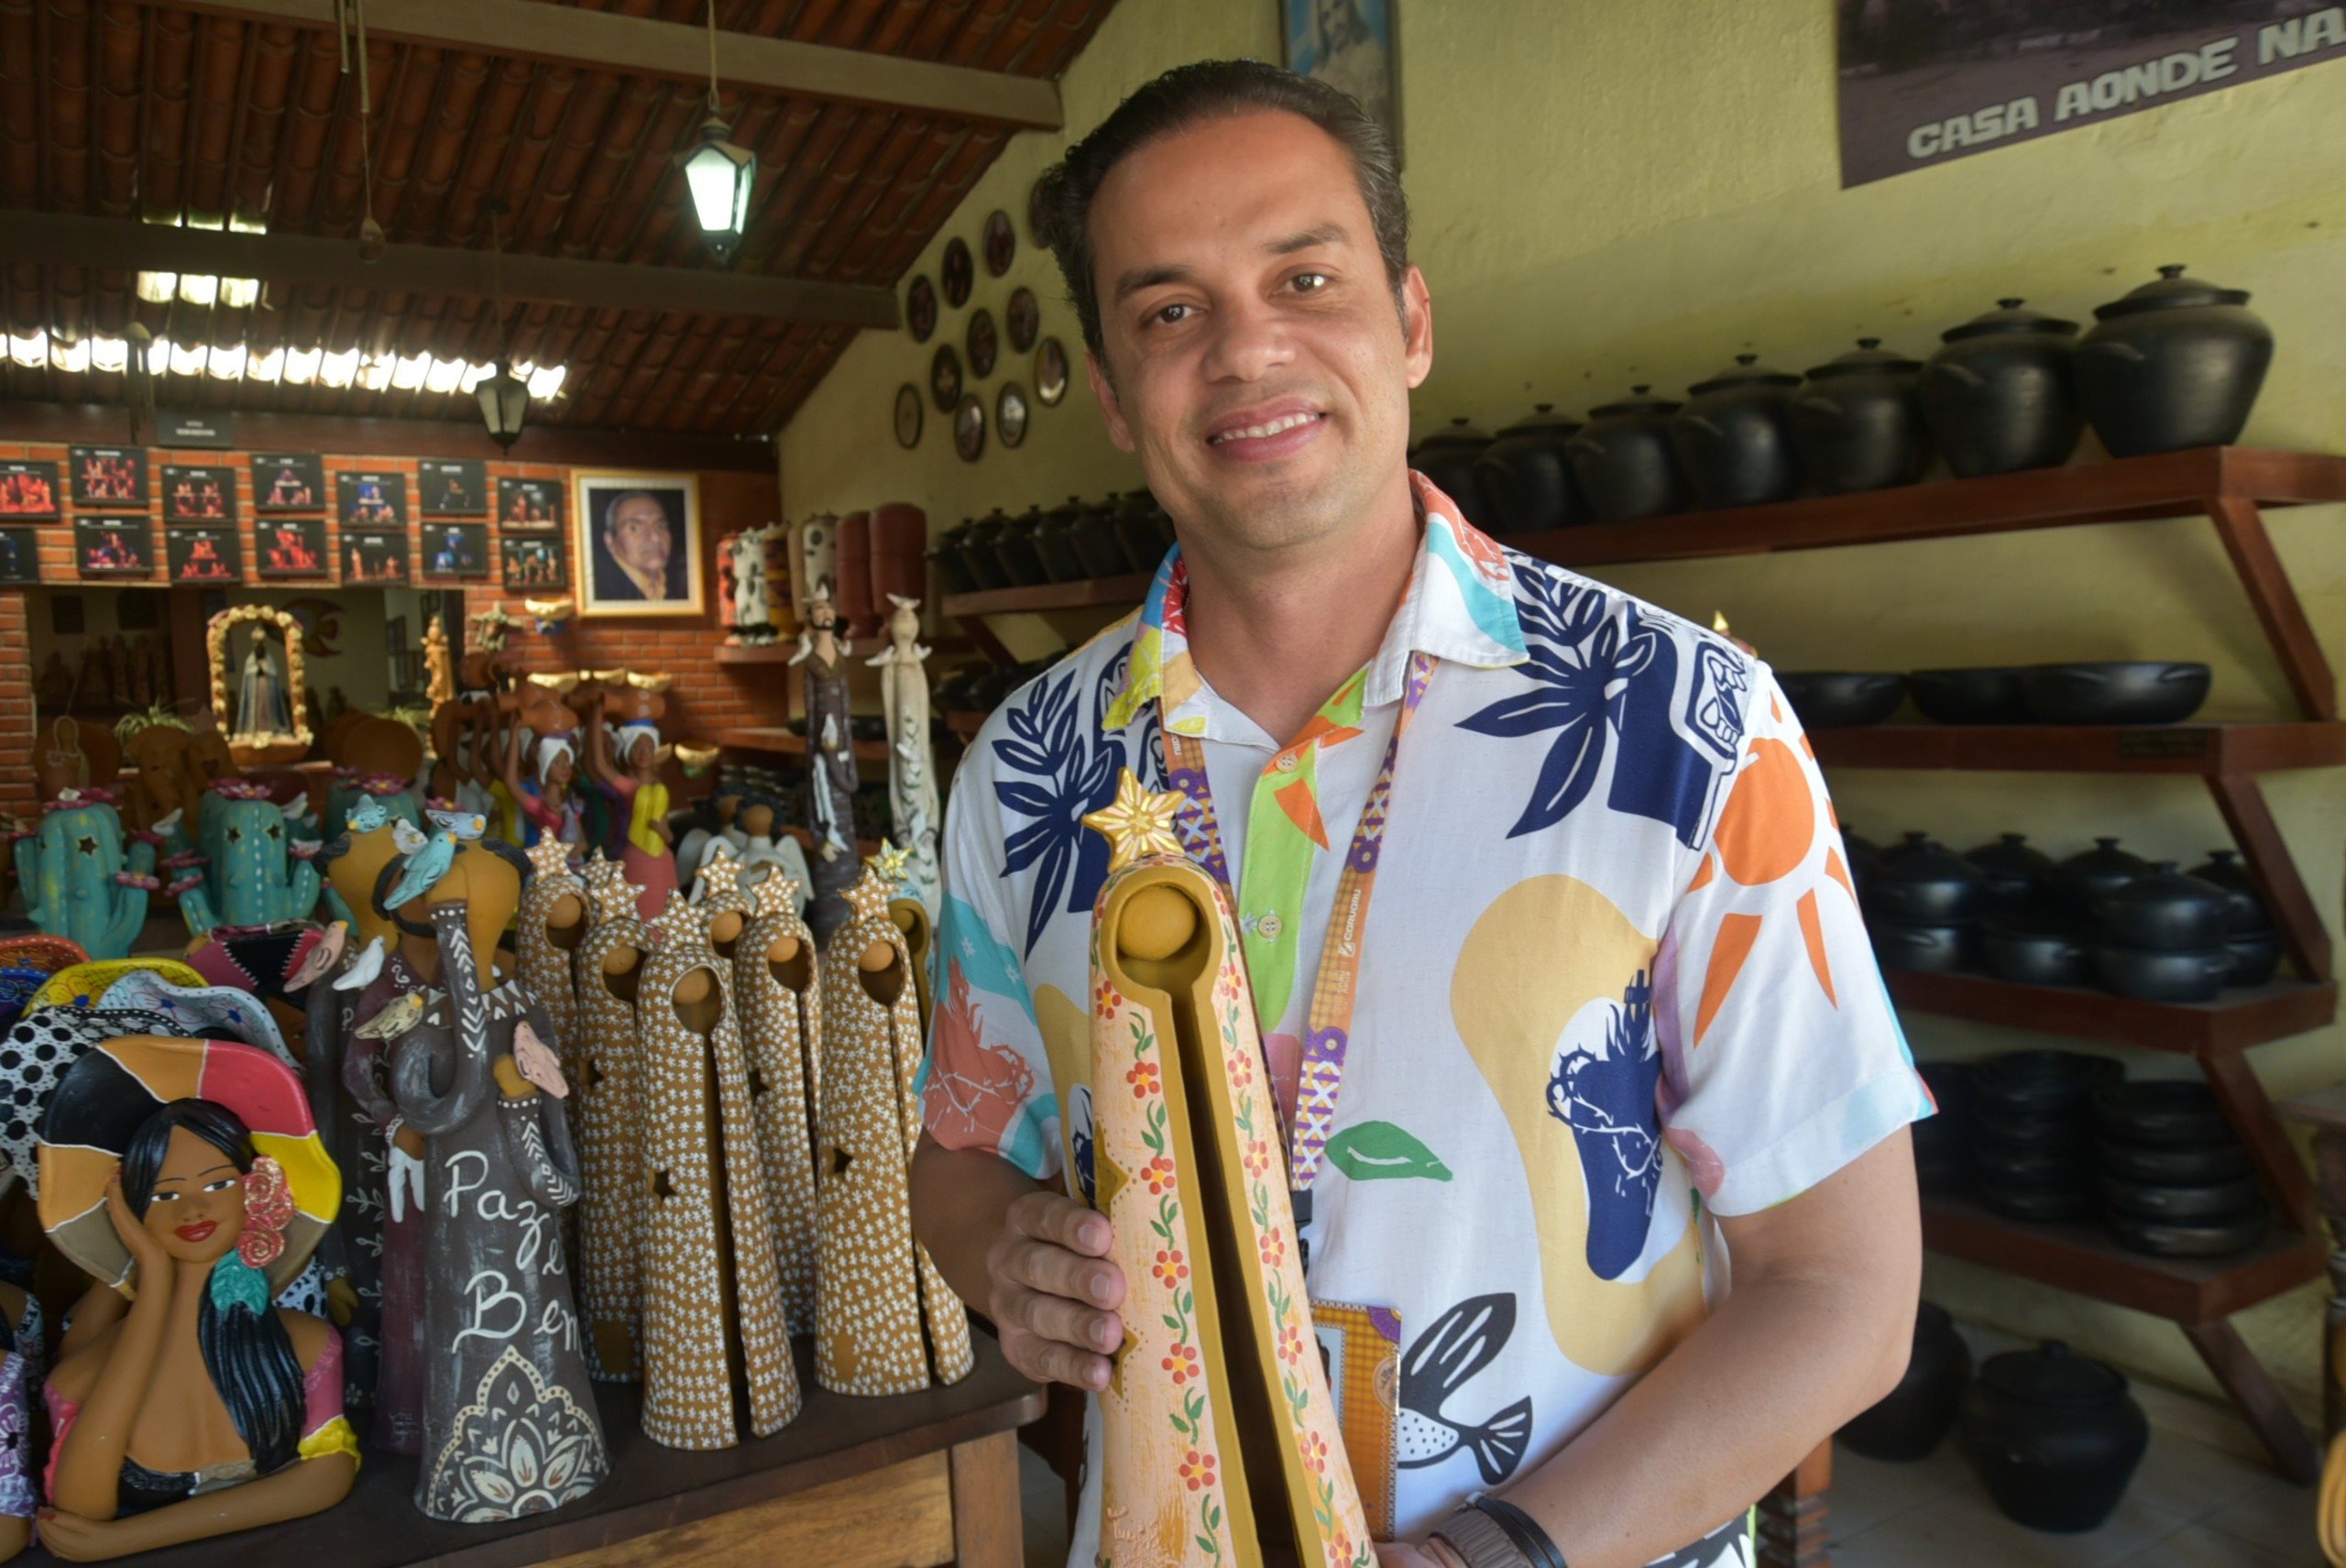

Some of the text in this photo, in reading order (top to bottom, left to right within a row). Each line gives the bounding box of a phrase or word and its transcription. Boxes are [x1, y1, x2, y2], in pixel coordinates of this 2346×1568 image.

[1907, 6, 2346, 159] CASA AONDE NA
[443, 1149, 551, 1271] Paz
[451, 1270, 586, 1361] Bem
